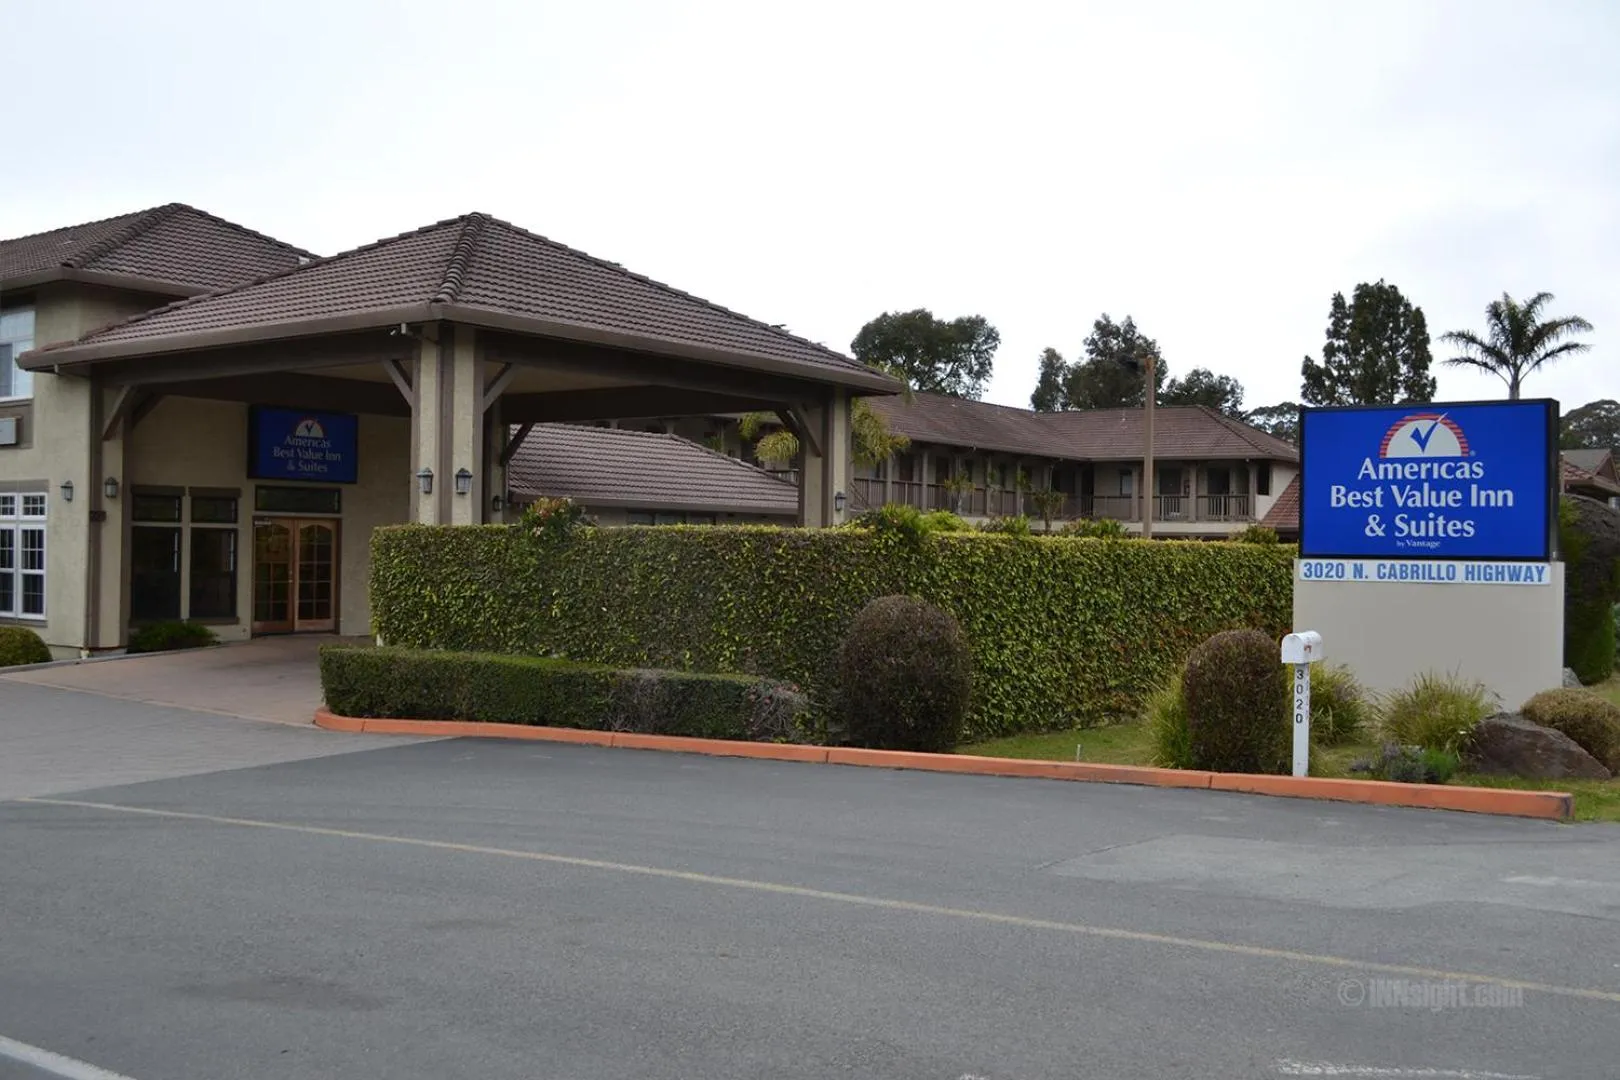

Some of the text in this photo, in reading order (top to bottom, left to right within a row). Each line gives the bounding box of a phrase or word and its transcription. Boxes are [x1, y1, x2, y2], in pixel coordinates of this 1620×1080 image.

[284, 436, 332, 447] Americas
[273, 446, 341, 461] Best Value Inn
[298, 460, 328, 472] Suites
[1357, 457, 1485, 481] Americas
[1330, 482, 1514, 508] Best Value Inn
[1364, 512, 1476, 538] & Suites
[1406, 539, 1441, 549] Vantage
[1303, 562, 1546, 583] 3020 N. CABRILLO HIGHWAY
[1295, 669, 1304, 724] 3020
